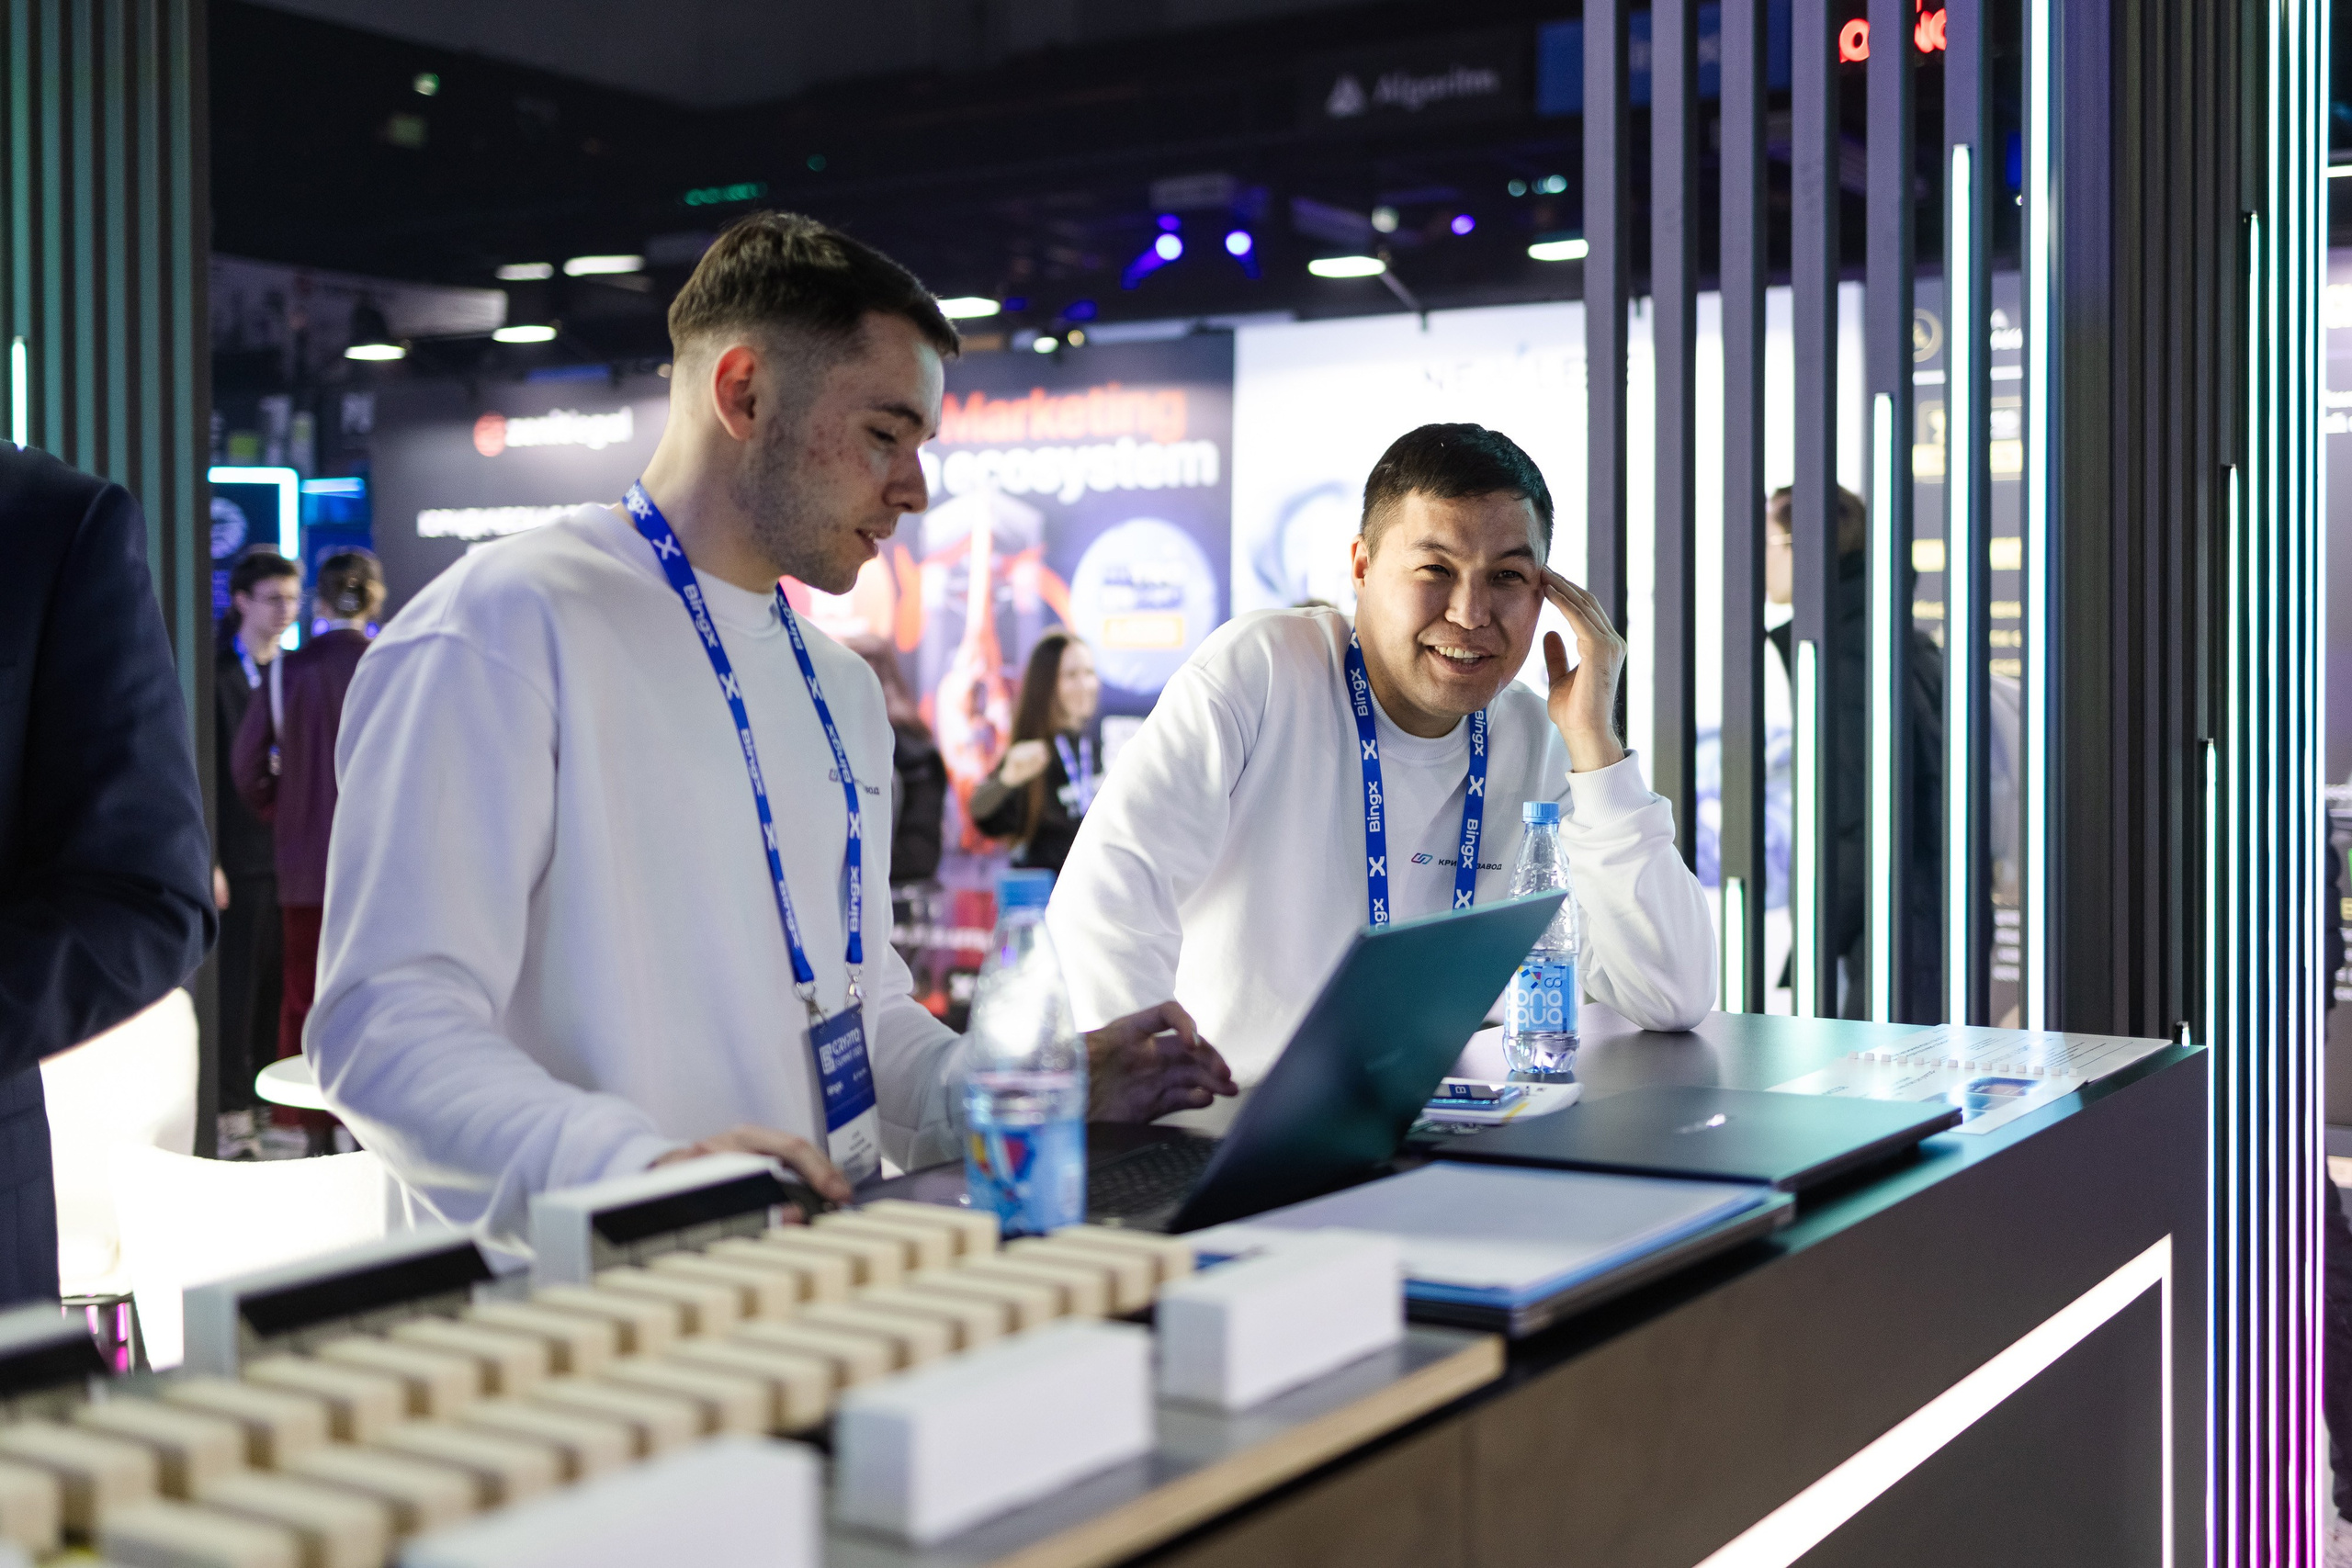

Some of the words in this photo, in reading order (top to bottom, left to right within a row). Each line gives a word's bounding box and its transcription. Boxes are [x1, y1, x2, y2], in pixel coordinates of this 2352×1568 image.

[938, 383, 1188, 445] Marketing
[942, 435, 1219, 503] ecosystem
[1438, 859, 1502, 871] КРИЗАВОД
